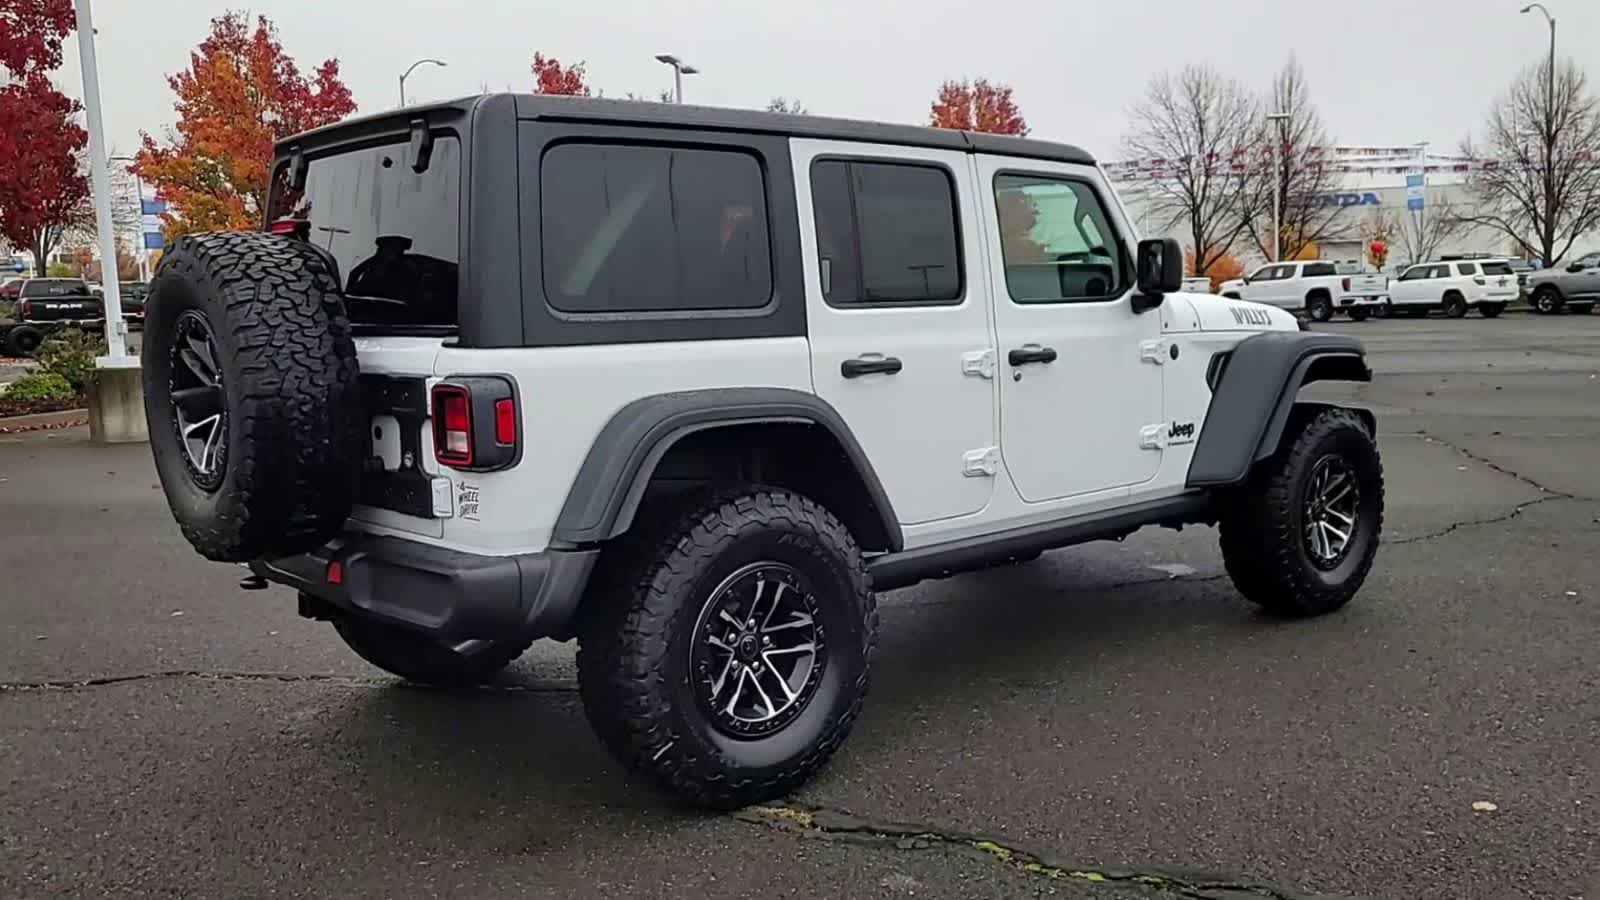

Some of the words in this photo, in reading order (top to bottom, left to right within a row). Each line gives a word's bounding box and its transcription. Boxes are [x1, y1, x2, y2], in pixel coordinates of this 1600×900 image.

[1168, 421, 1195, 438] Jeep
[458, 490, 479, 504] WHEEL
[458, 503, 479, 518] DRIVE
